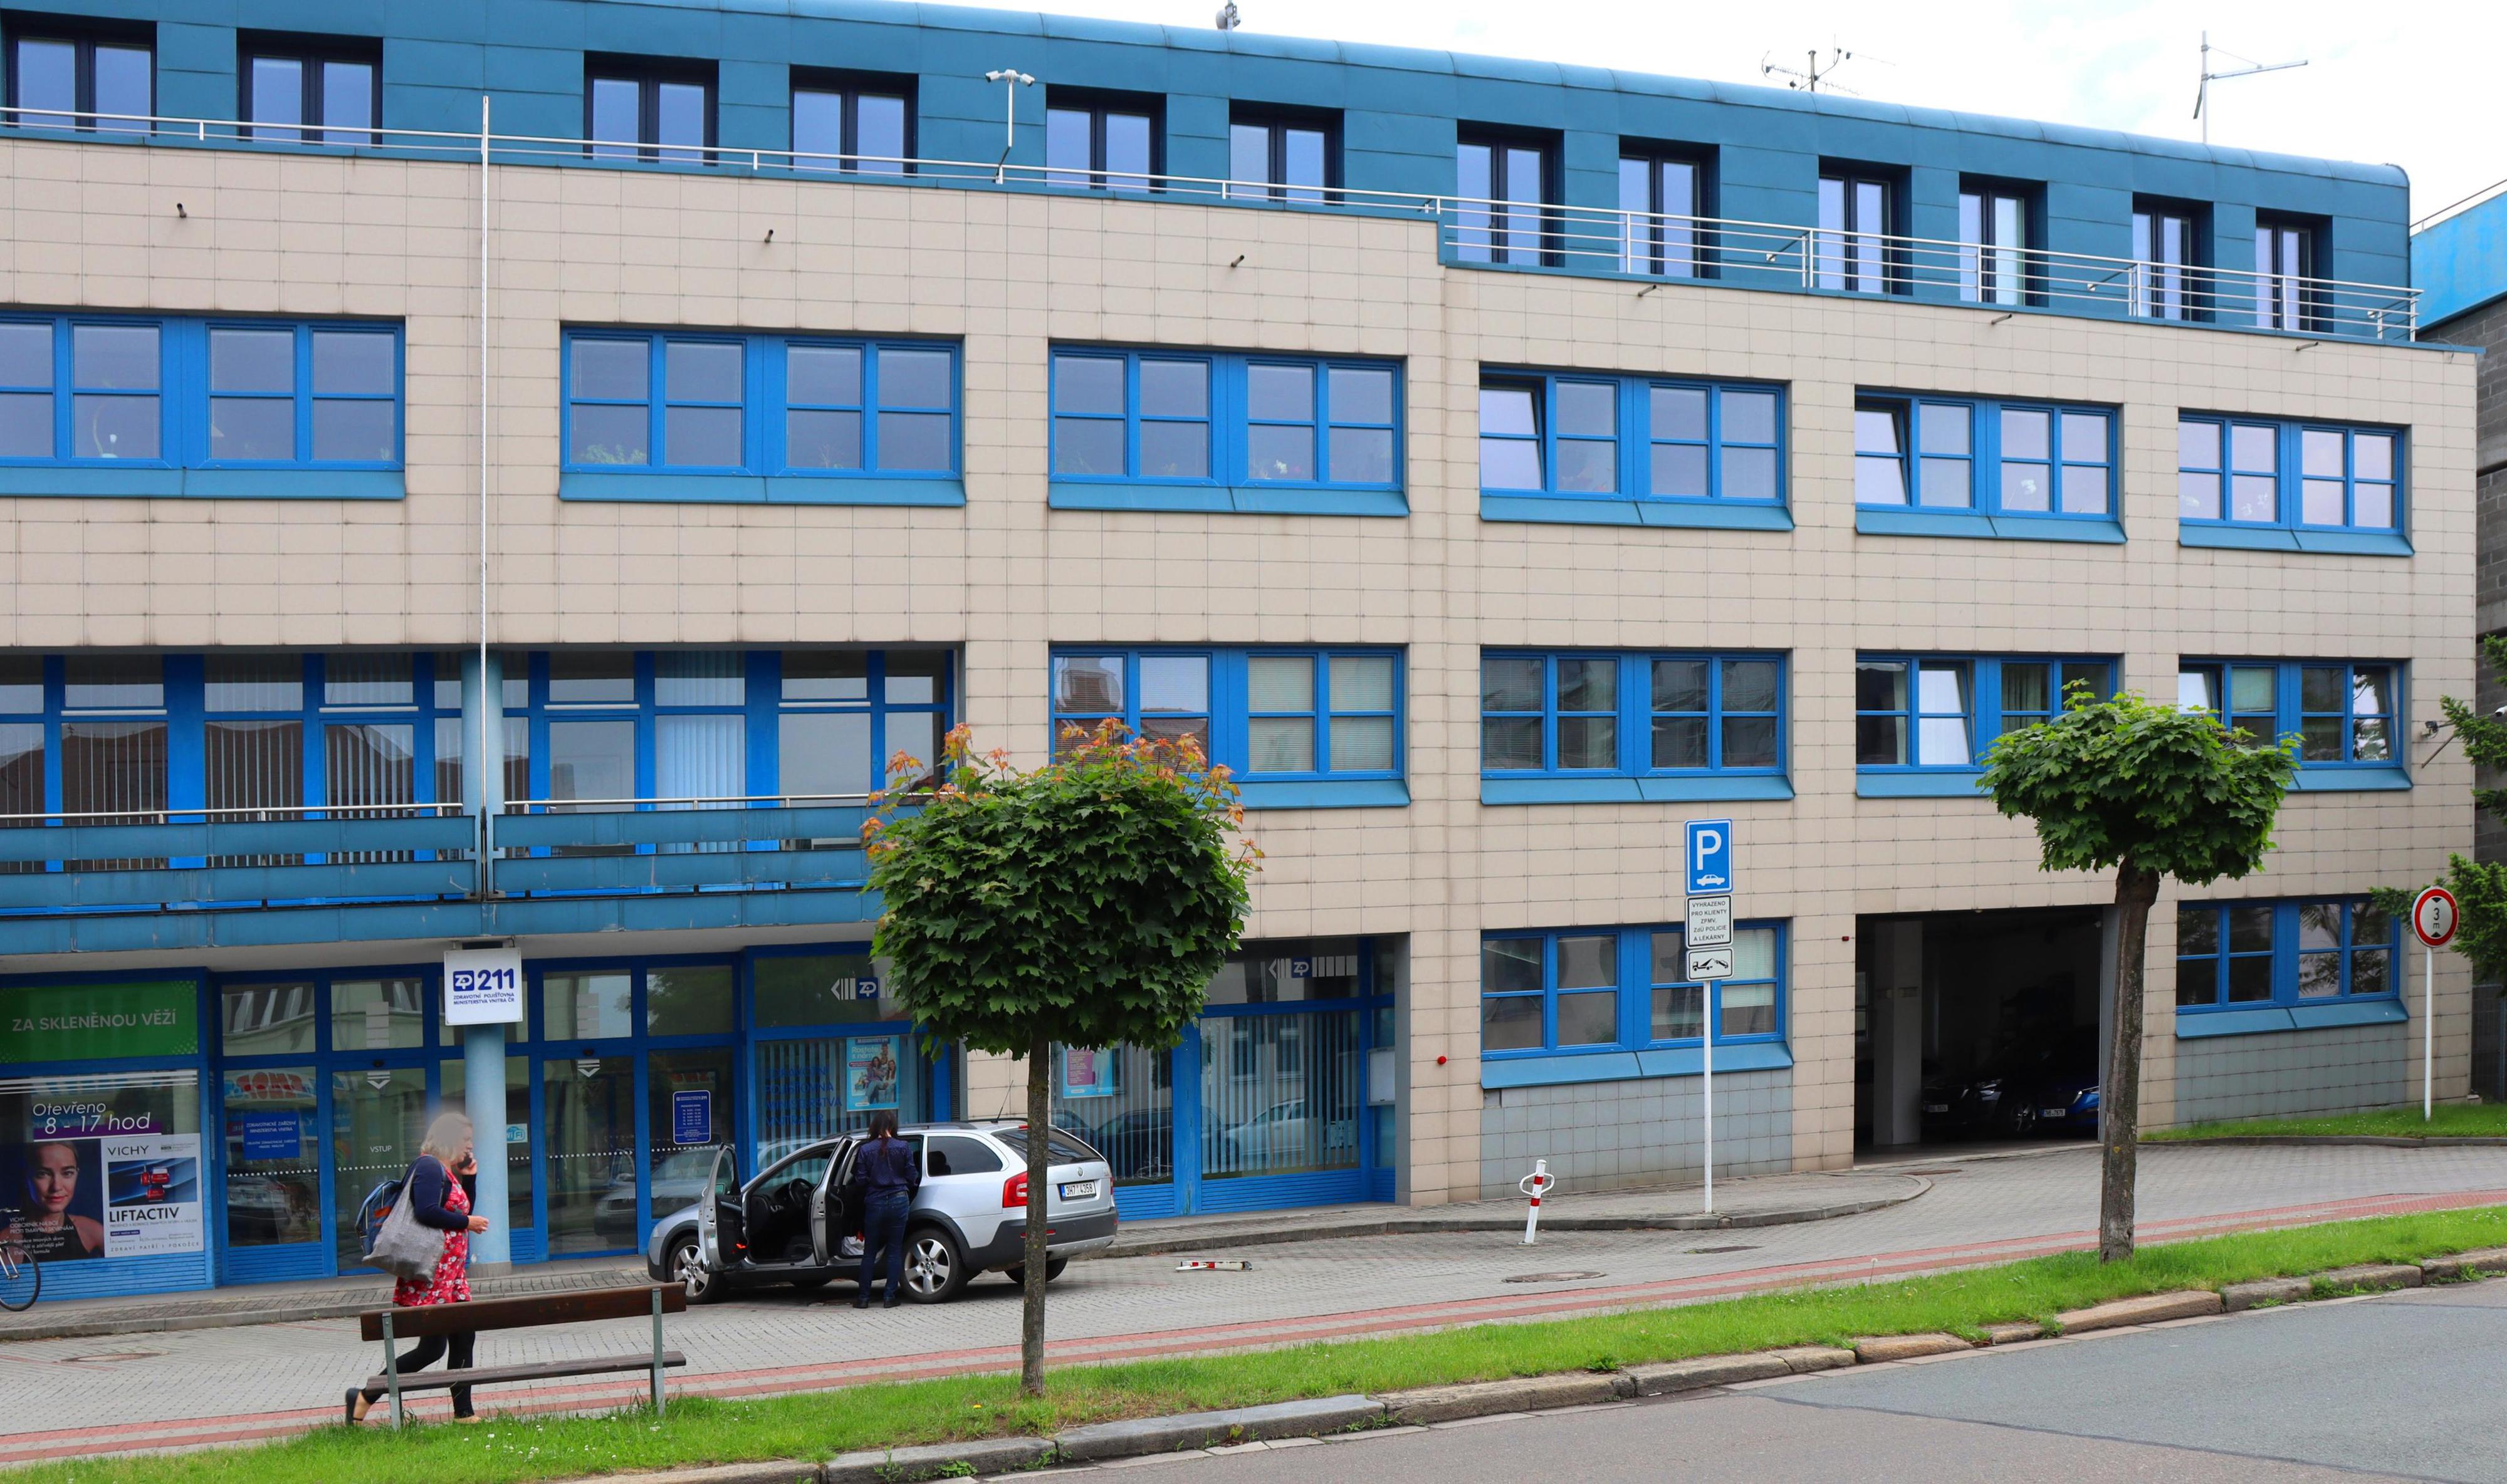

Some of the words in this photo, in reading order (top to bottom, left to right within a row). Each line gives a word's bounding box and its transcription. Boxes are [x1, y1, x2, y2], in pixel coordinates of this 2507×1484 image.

[1697, 830, 1722, 870] P
[2433, 907, 2440, 921] 3
[478, 968, 514, 990] 211
[12, 1018, 34, 1032] ZA
[39, 1012, 136, 1030] SKLENĚNOU
[142, 1008, 176, 1025] VĚŽÍ
[33, 1102, 106, 1117] Otevřeno
[44, 1117, 57, 1134] 8
[81, 1116, 101, 1132] 17
[108, 1112, 151, 1131] hod
[107, 1145, 149, 1156] VICHY
[109, 1207, 179, 1223] LIFTACTIV
